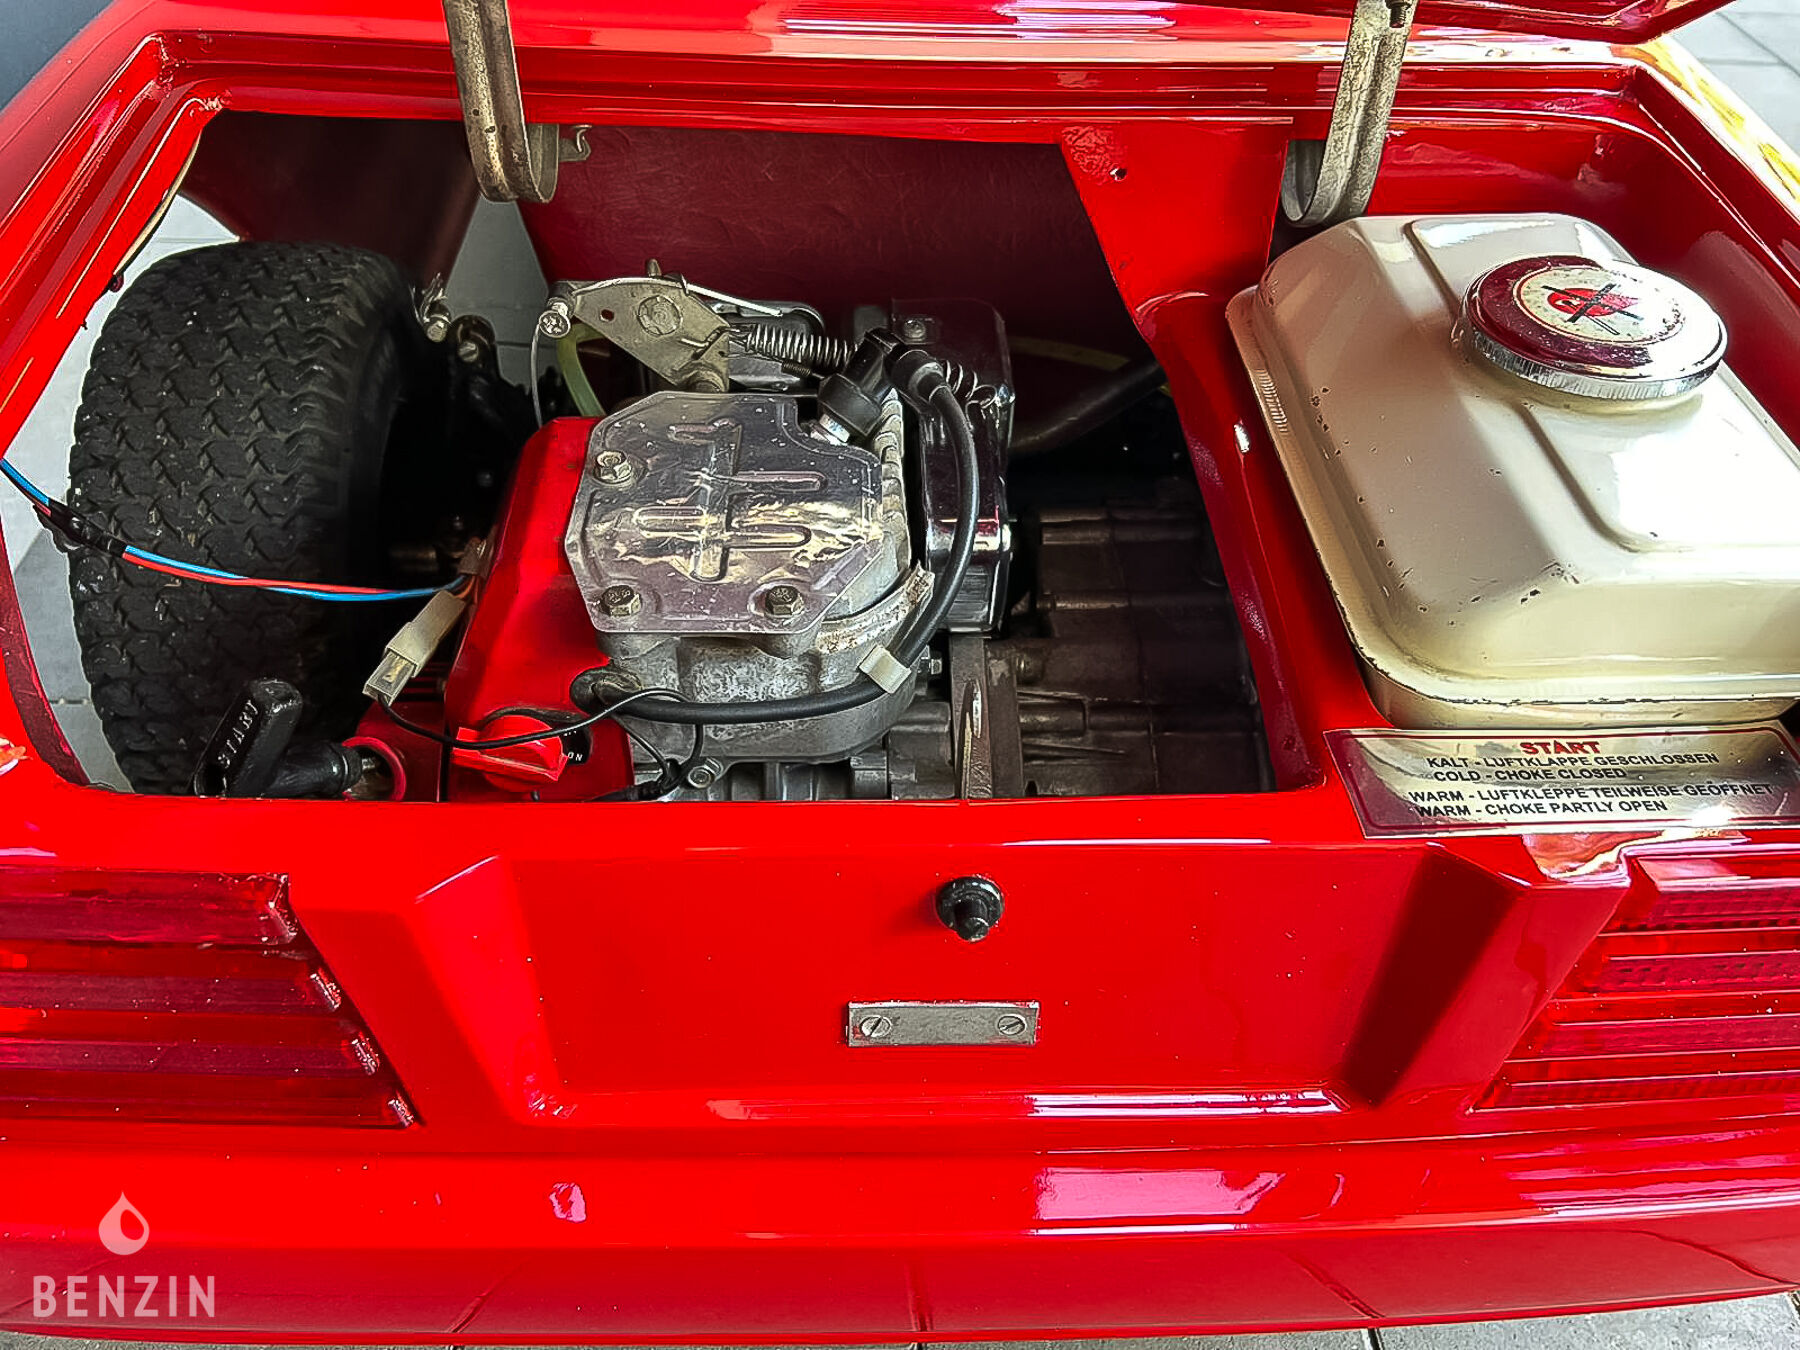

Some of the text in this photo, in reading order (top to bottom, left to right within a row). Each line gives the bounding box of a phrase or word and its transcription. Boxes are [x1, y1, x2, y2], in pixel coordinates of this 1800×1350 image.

[1519, 740, 1601, 755] START
[567, 751, 583, 761] ON
[1426, 757, 1469, 768] KALT
[1483, 756, 1592, 768] LUFTKLAPPE
[1593, 753, 1720, 766] GESCHLOSSEN
[1433, 770, 1481, 782] COLD
[1494, 769, 1556, 781] CHOKE
[1557, 768, 1627, 780] CLOSED
[1408, 790, 1465, 803] WARM
[1477, 787, 1590, 801] LUFTKLEPPE
[1592, 785, 1682, 798] TEILWEISE
[1684, 780, 1774, 797] GEÖFFNET
[1414, 804, 1472, 818] WARM
[1484, 802, 1548, 816] CHOKE
[1549, 801, 1615, 815] PARTLY
[1618, 799, 1668, 813] OPEN
